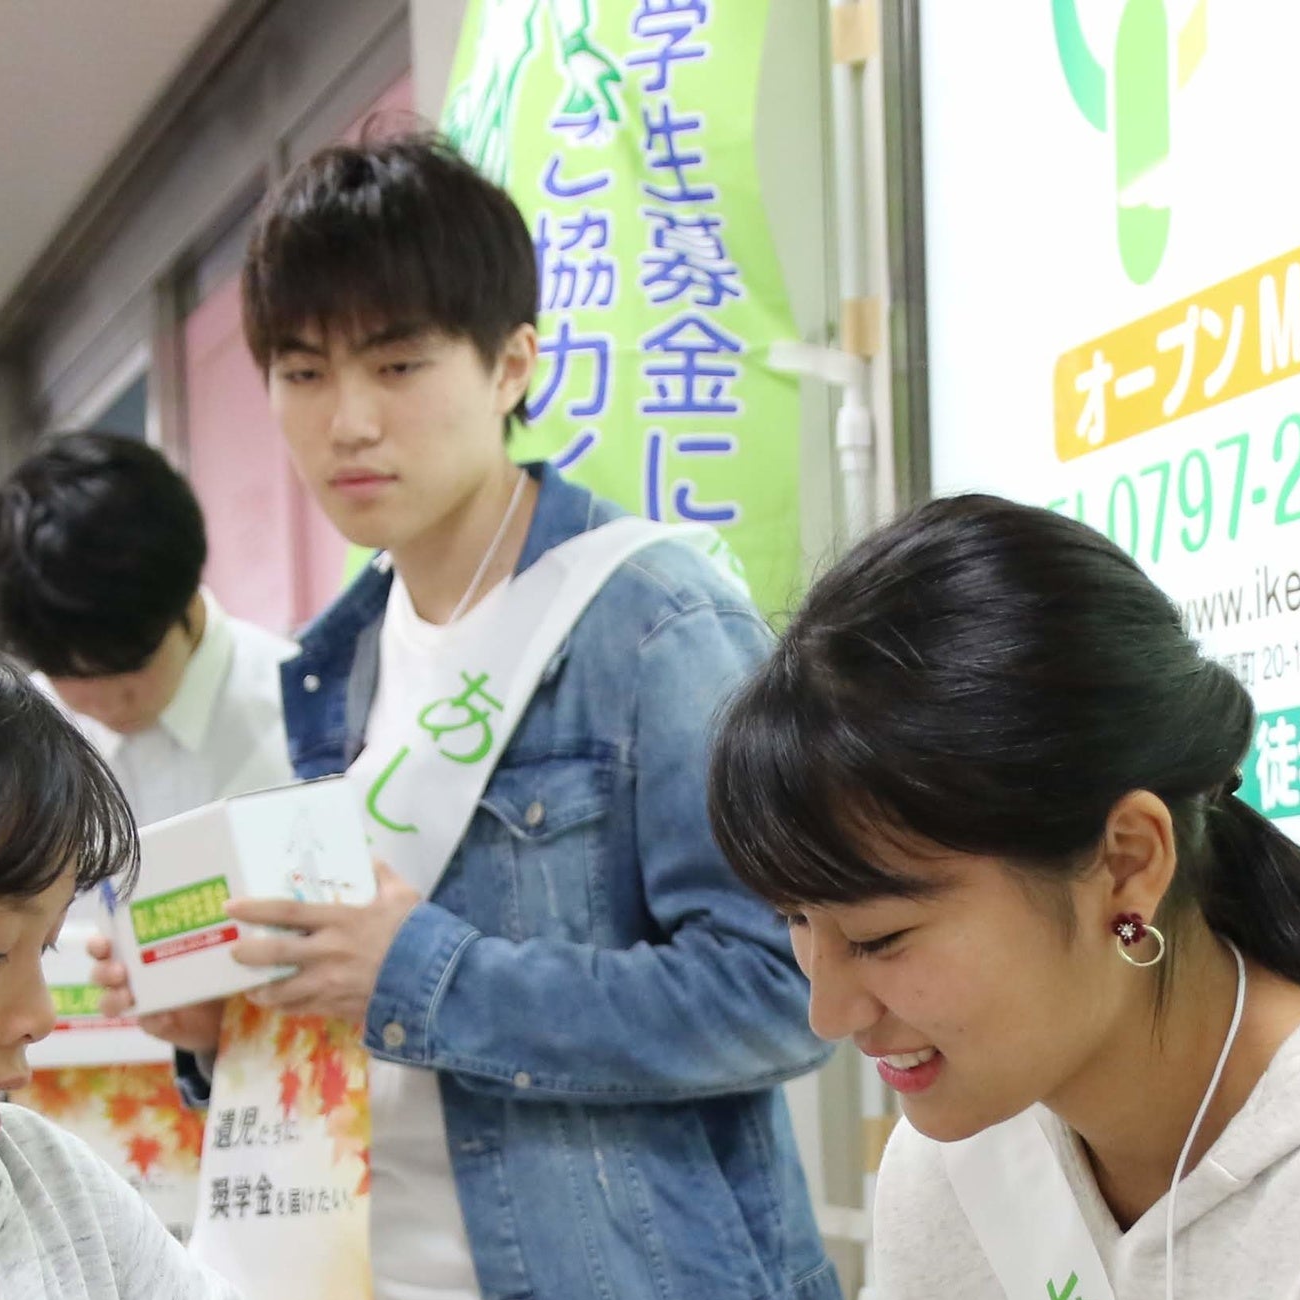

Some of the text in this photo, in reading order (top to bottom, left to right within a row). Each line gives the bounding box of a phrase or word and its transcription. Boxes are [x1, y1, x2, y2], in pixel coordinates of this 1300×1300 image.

[626, 0, 741, 521] 学生募金に
